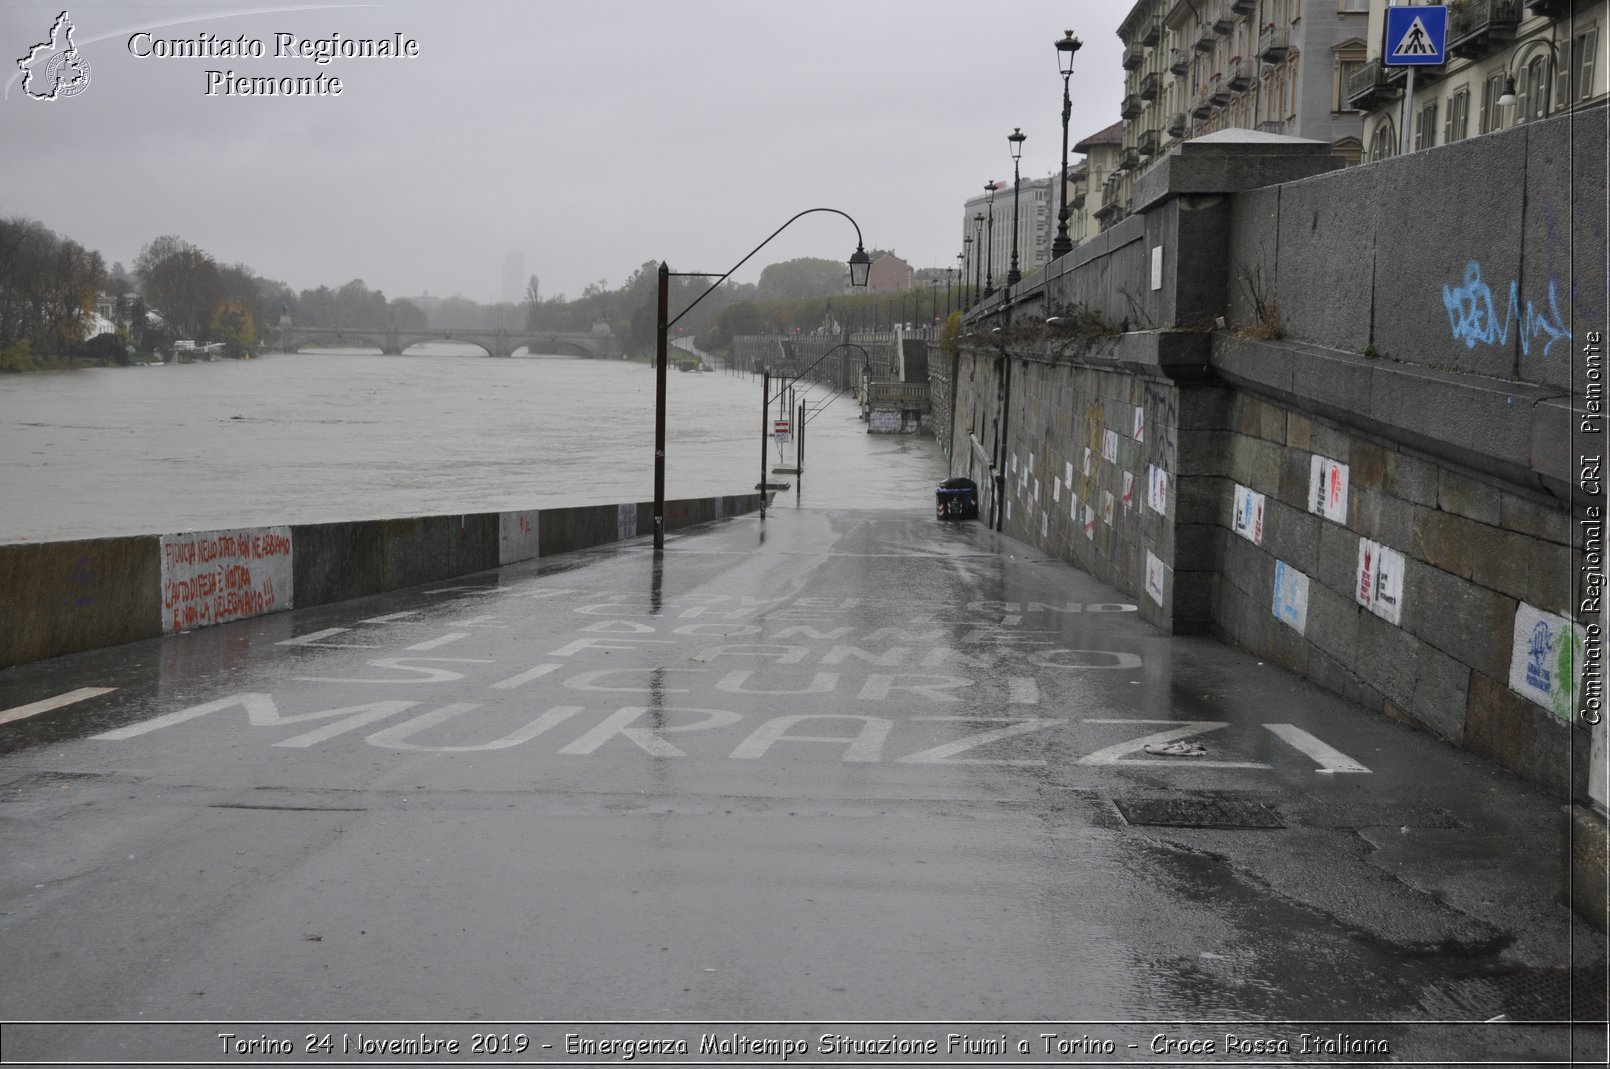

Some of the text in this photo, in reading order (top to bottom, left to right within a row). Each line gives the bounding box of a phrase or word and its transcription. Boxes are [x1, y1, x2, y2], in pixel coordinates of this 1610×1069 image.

[164, 541, 195, 571] FIDUCIA
[197, 538, 217, 565] NELLO
[218, 534, 236, 558] STATO
[237, 532, 250, 560] NON
[173, 607, 183, 631] E
[182, 602, 199, 625] NON
[358, 611, 1062, 645] LE DONNE
[572, 603, 847, 621] CHE
[273, 627, 1144, 670] LI FANNO
[288, 656, 1041, 705] SICURI
[90, 691, 1373, 775] MURAZZI
